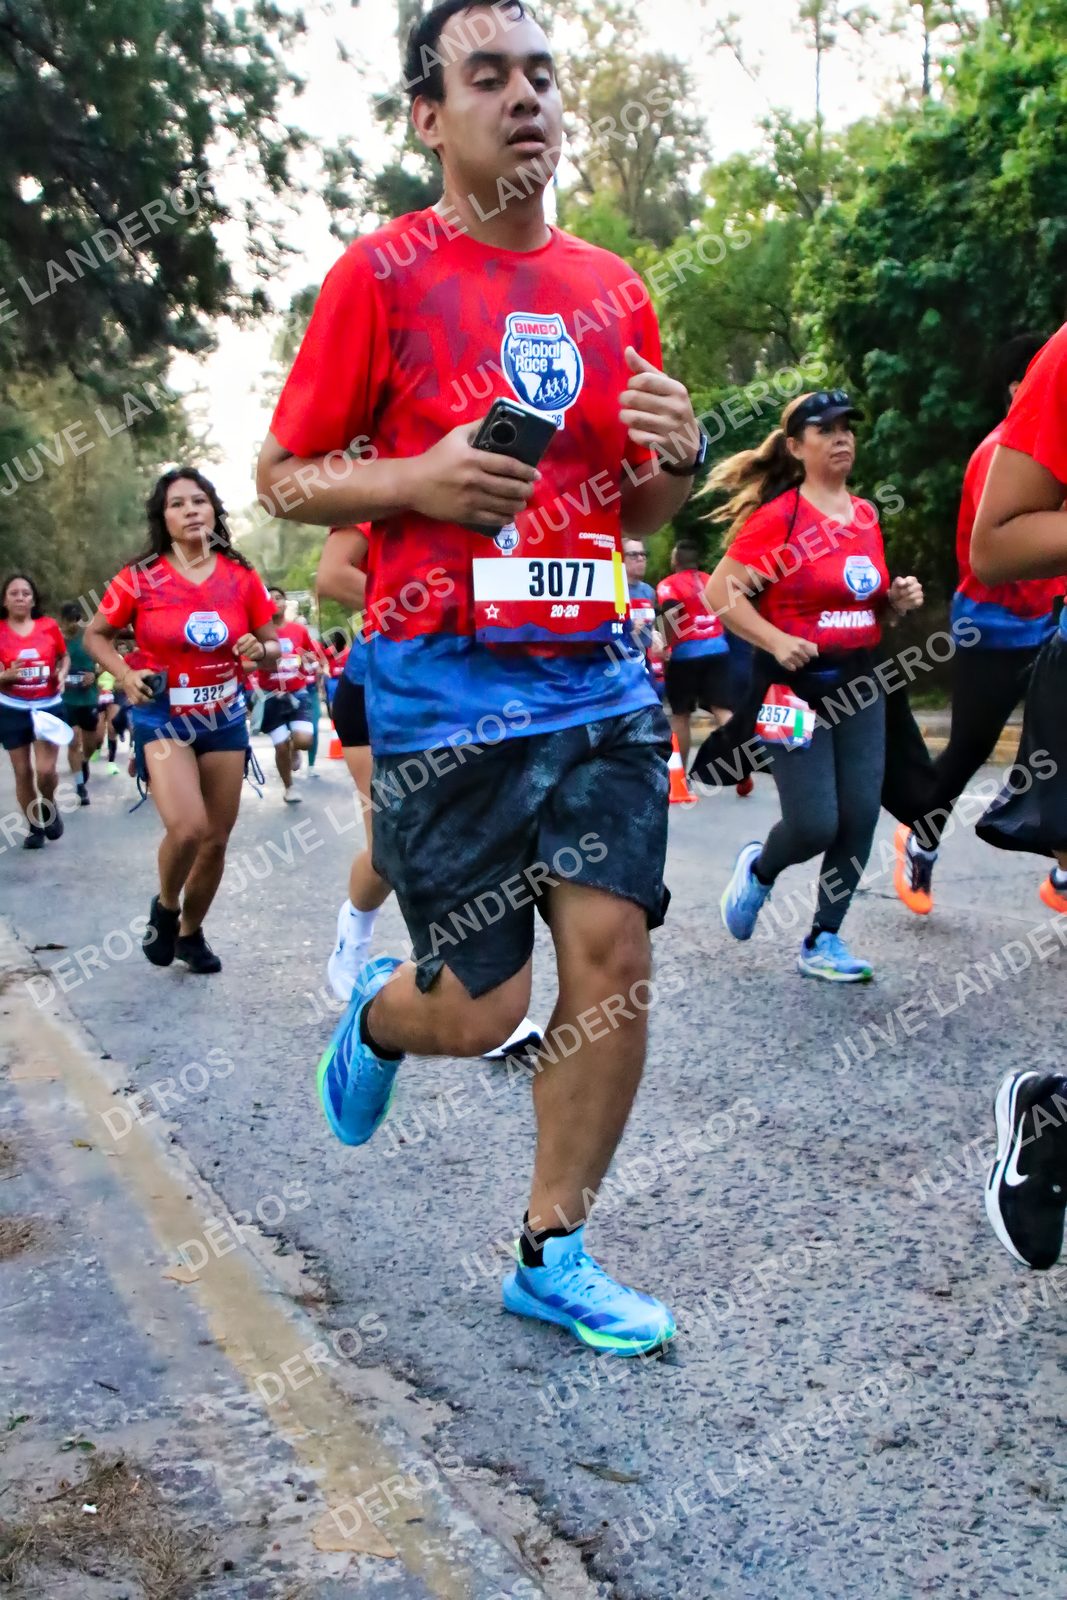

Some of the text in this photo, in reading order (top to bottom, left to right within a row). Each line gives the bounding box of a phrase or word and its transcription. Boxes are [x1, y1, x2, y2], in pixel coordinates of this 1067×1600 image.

[514, 322, 558, 335] BIMBO
[520, 340, 560, 358] Global
[515, 356, 548, 373] Race
[528, 561, 595, 597] 3077
[611, 622, 624, 634] 5K
[193, 684, 225, 704] 2322
[758, 704, 790, 724] 2357
